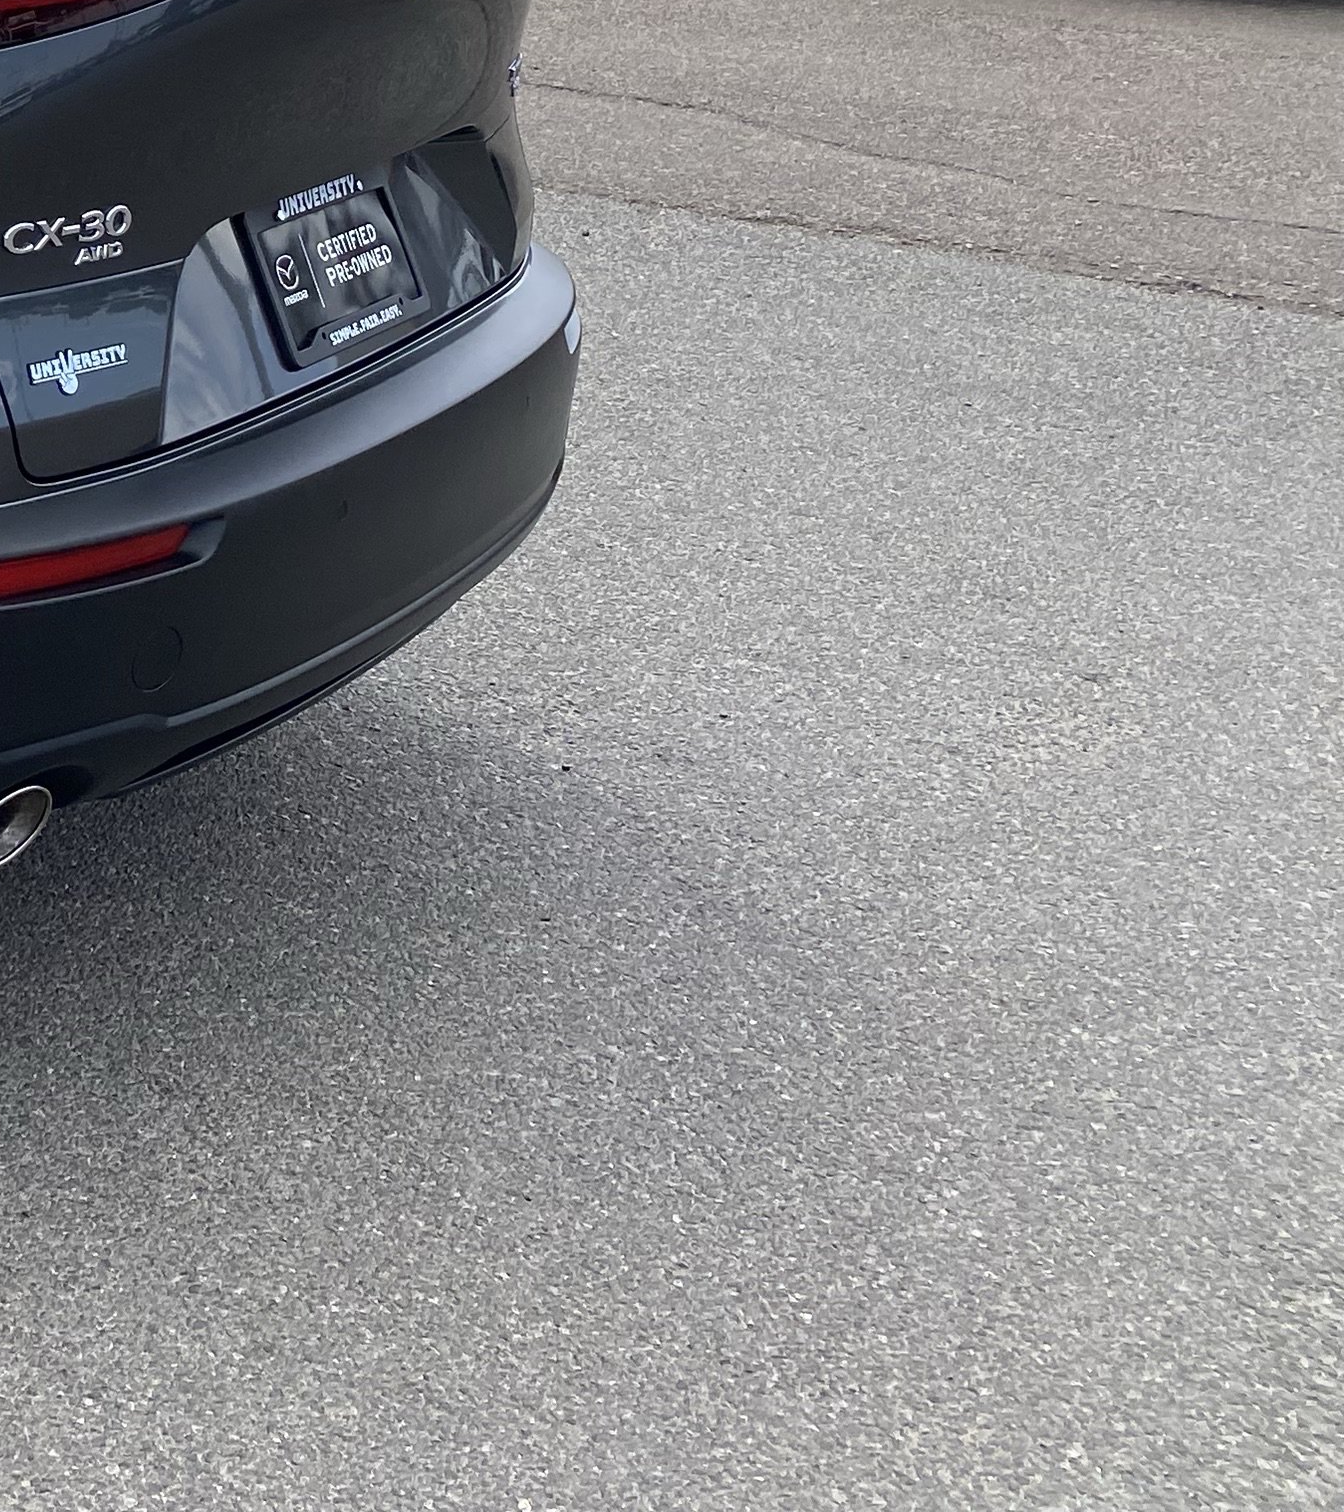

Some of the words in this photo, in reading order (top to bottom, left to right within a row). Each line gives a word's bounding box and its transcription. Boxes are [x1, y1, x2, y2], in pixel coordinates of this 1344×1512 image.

[279, 174, 355, 219] UNIVERSITY
[3, 204, 132, 255] CX-30
[317, 223, 377, 262] CERTIFIED
[74, 241, 124, 266] AWD
[325, 244, 393, 287] PRE-OWNED
[30, 343, 127, 381] UNIVERSITY
